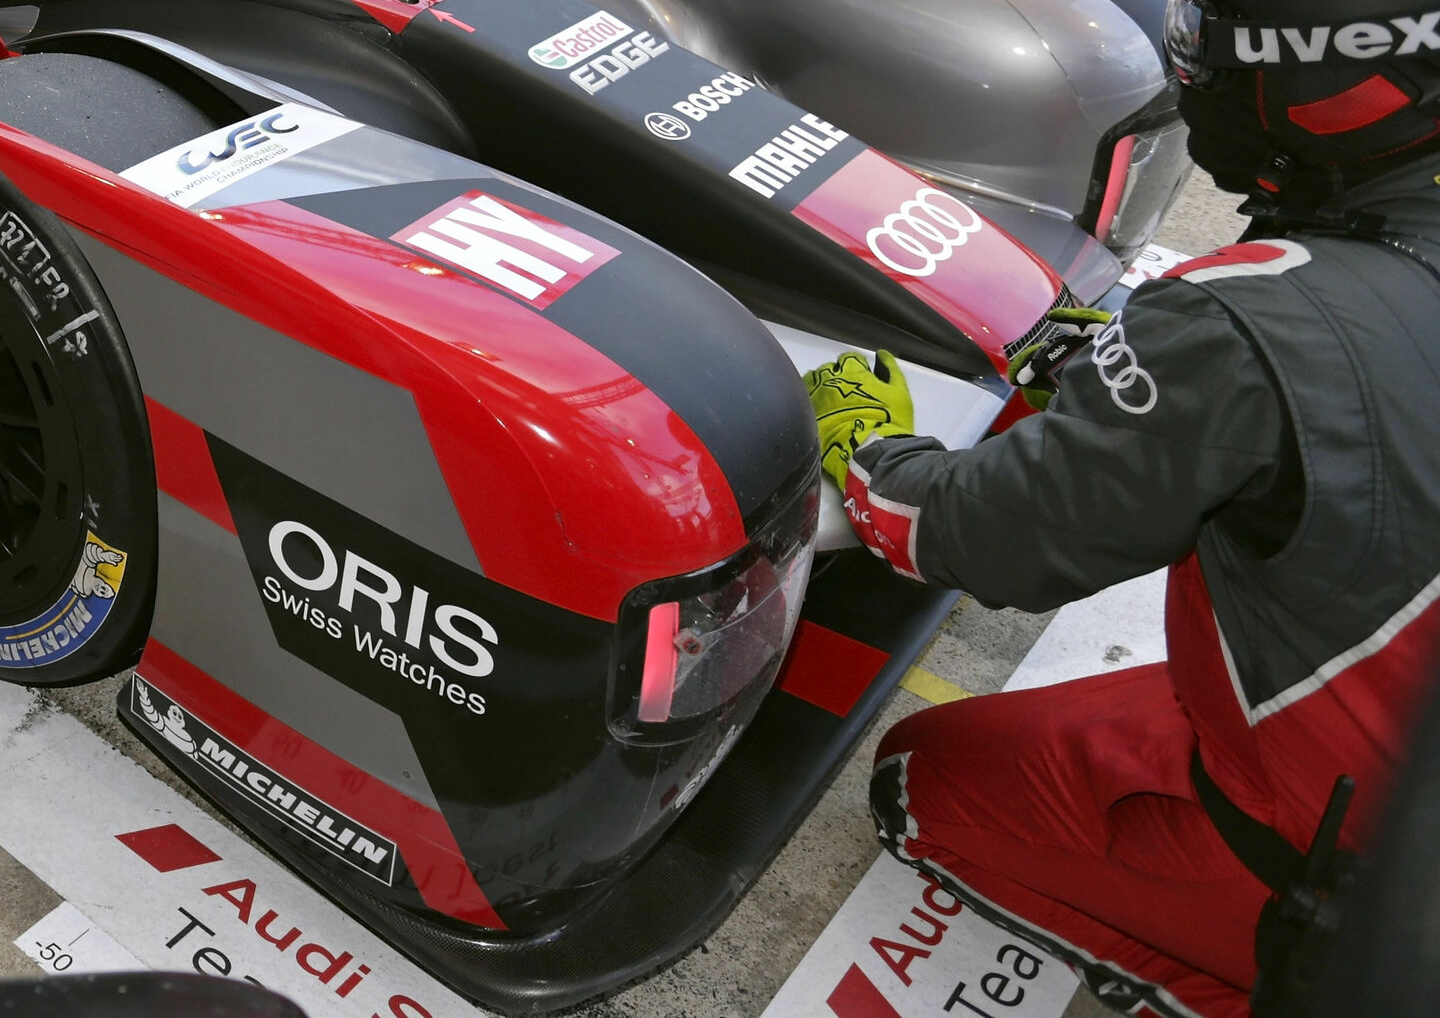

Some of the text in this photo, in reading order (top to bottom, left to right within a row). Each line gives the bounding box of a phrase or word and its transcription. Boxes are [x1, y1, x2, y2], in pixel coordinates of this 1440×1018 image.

[553, 16, 623, 56] Castrol
[569, 30, 670, 95] EDGE
[1234, 11, 1440, 64] uvex
[672, 70, 755, 122] BOSCH
[176, 113, 299, 176] WEC
[216, 147, 289, 184] CHAMPIONSHIP
[728, 113, 849, 198] MAHLE
[406, 195, 594, 301] HY
[1048, 343, 1068, 362] Robic
[268, 520, 499, 678] ORIS
[263, 576, 486, 716] Swiss Watches
[200, 737, 387, 864] MICHELIN
[34, 939, 74, 972] -50
[201, 878, 371, 998] Audi
[869, 875, 965, 987] Aud
[943, 941, 1044, 1018] Tea
